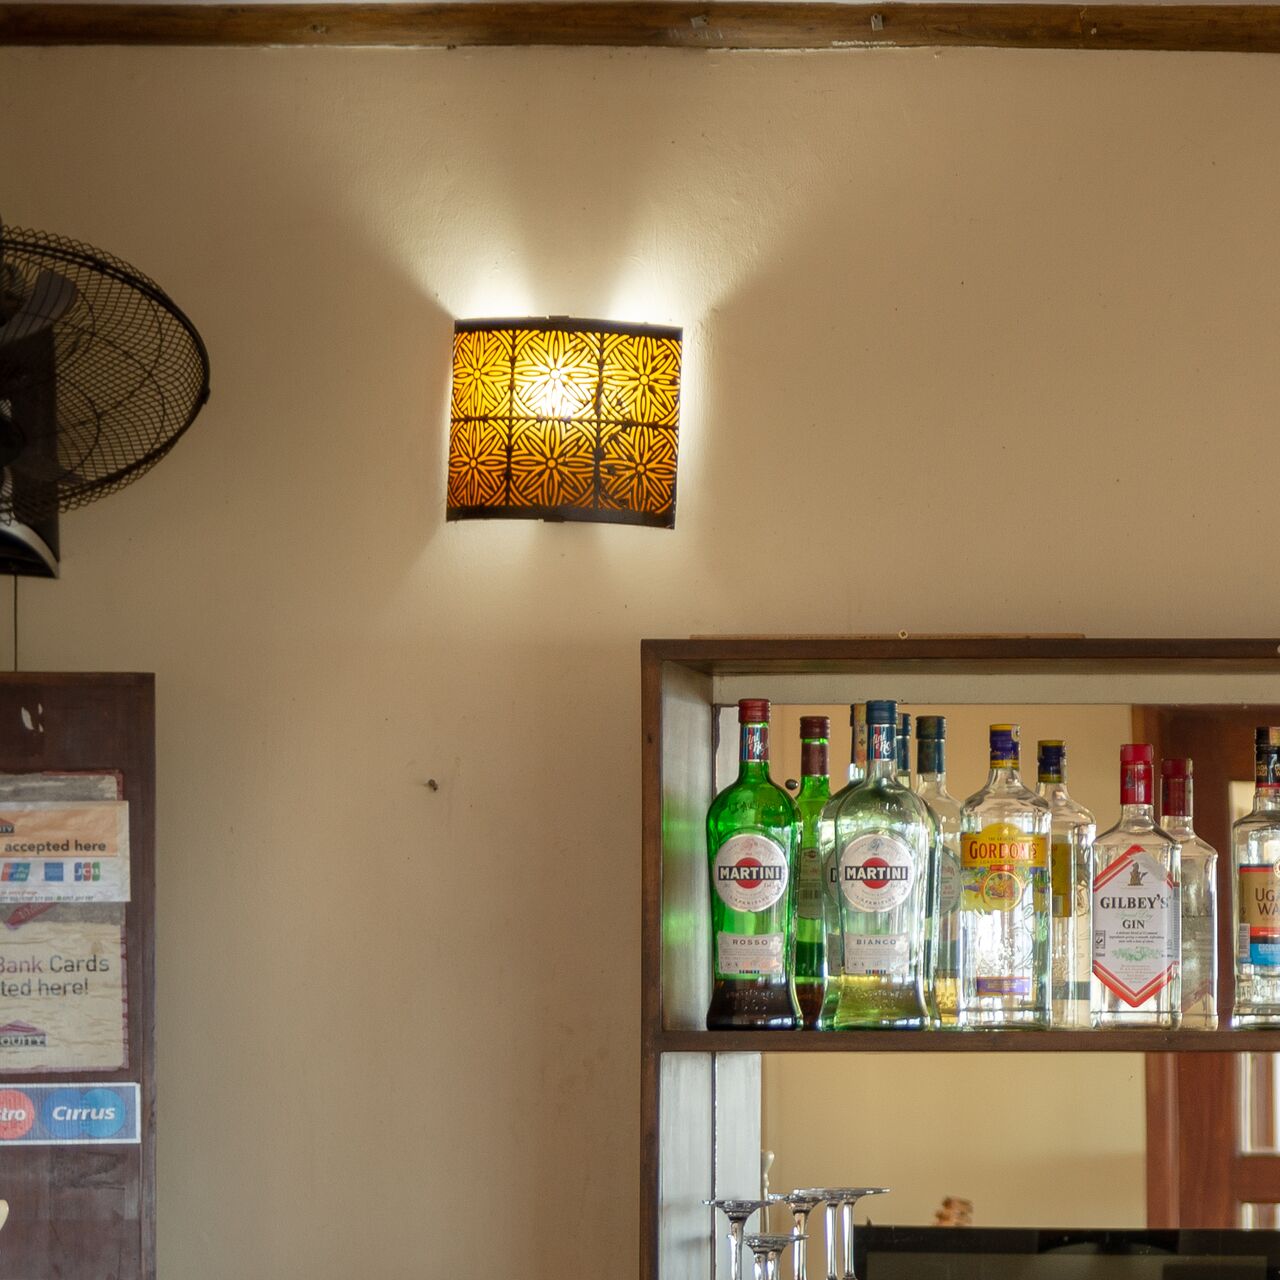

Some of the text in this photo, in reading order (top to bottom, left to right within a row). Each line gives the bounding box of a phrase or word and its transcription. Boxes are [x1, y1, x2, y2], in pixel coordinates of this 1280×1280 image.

[5, 839, 107, 855] accepted here
[719, 866, 782, 880] MARTINI
[845, 866, 908, 880] MARTINI
[1122, 919, 1146, 929] GIN
[732, 938, 769, 946] ROSSO
[856, 938, 897, 946] BIANCO
[50, 954, 110, 973] Cards
[38, 979, 90, 996] here!
[52, 1105, 116, 1121] Cirrus
